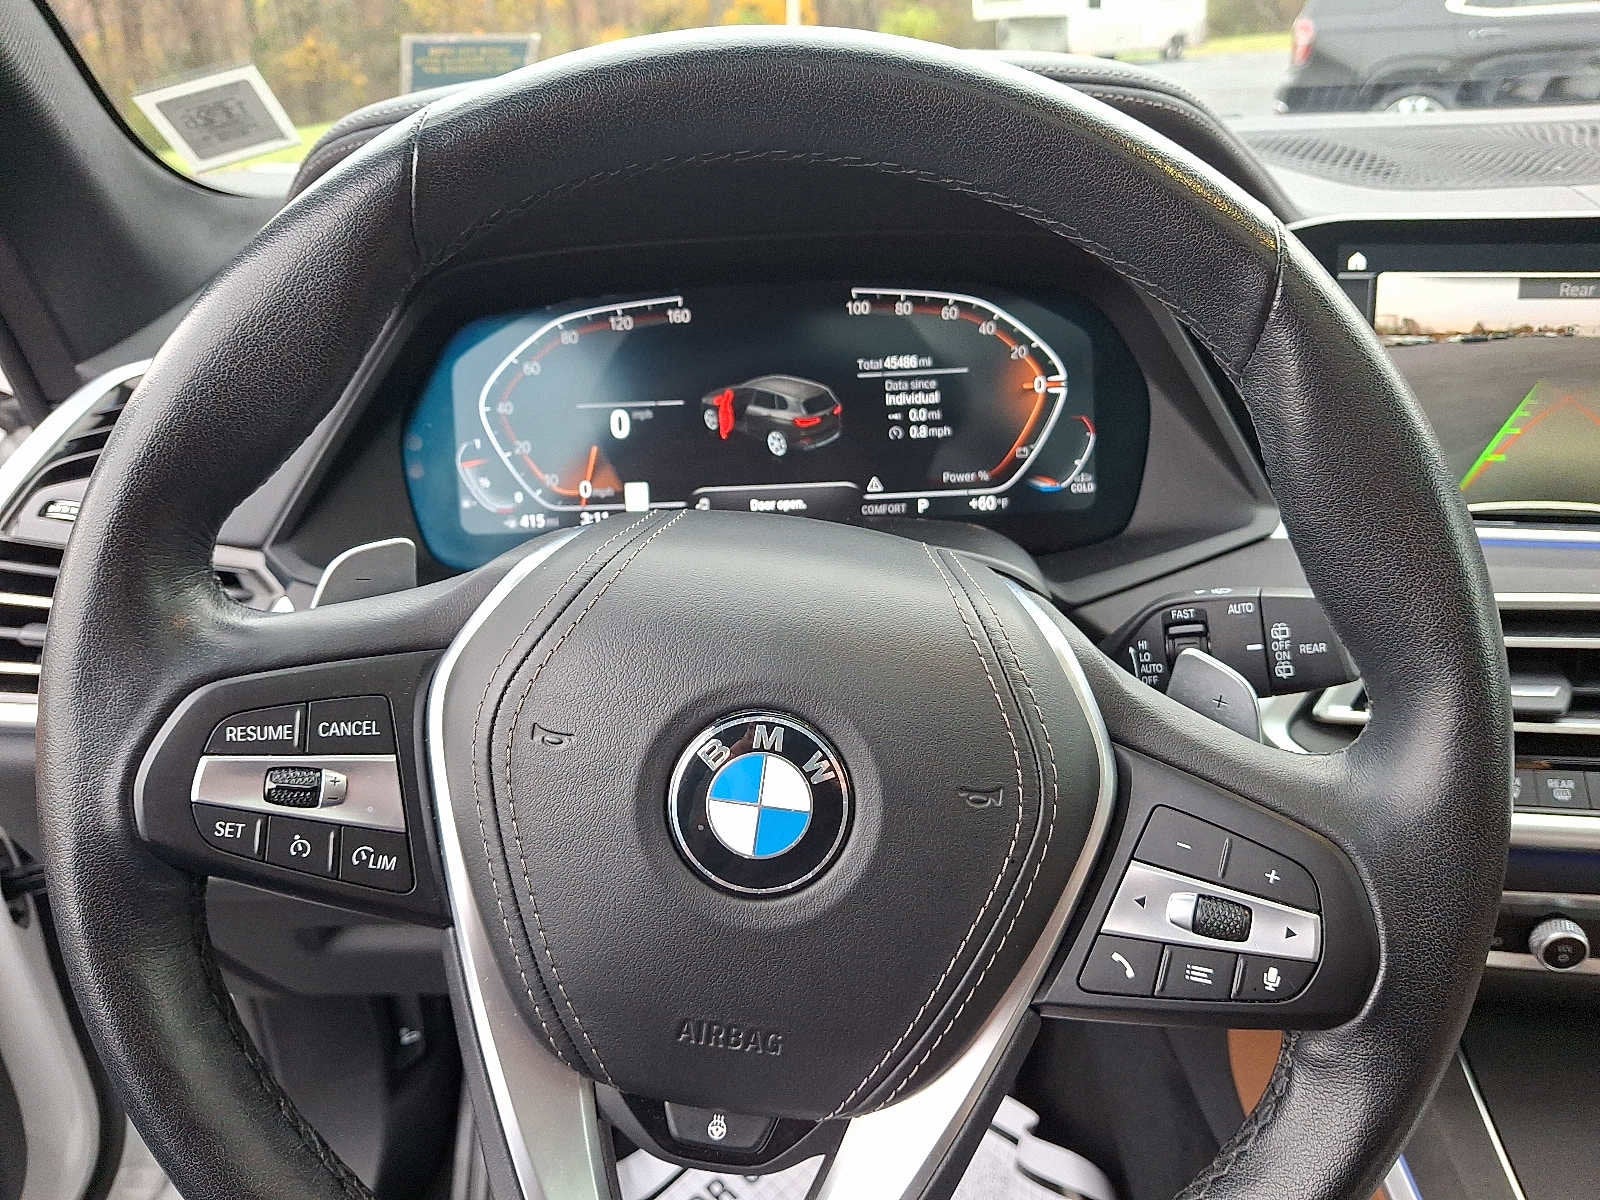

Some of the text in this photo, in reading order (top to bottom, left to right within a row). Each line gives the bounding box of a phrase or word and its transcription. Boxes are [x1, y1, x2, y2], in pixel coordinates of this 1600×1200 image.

[1560, 282, 1595, 297] Rear
[846, 302, 870, 315] 100
[894, 301, 913, 316] 80
[941, 306, 959, 320] 60
[609, 315, 634, 331] 120
[666, 309, 691, 324] 160
[979, 320, 997, 335] 40
[1010, 344, 1028, 359] 20
[857, 359, 882, 370] Total
[884, 355, 917, 369] 45486
[885, 380, 936, 391] Data since
[1033, 375, 1047, 393] 0
[885, 390, 941, 406] Individual
[909, 408, 927, 421] 0.0
[609, 408, 631, 439] 0
[909, 424, 953, 438] 0.8 mph
[943, 471, 977, 483] Power
[579, 480, 593, 498] 0
[1071, 482, 1096, 494] COLD
[862, 503, 906, 516] COMFORT
[918, 499, 930, 514] P
[520, 513, 546, 528] 415
[1171, 609, 1195, 619] FAST
[1228, 603, 1255, 615] AUTO
[1137, 640, 1147, 650] HI
[1272, 641, 1290, 651] OFF
[1299, 643, 1327, 654] REAR
[1139, 651, 1151, 662] LO
[1275, 651, 1291, 661] ON
[1141, 663, 1163, 673] AUTO
[225, 724, 294, 742] RESUME
[317, 720, 381, 738] CANCEL
[696, 724, 836, 785] BMW
[214, 821, 246, 839] SET
[368, 854, 398, 871] LIM
[677, 1021, 784, 1057] AIRBAG
